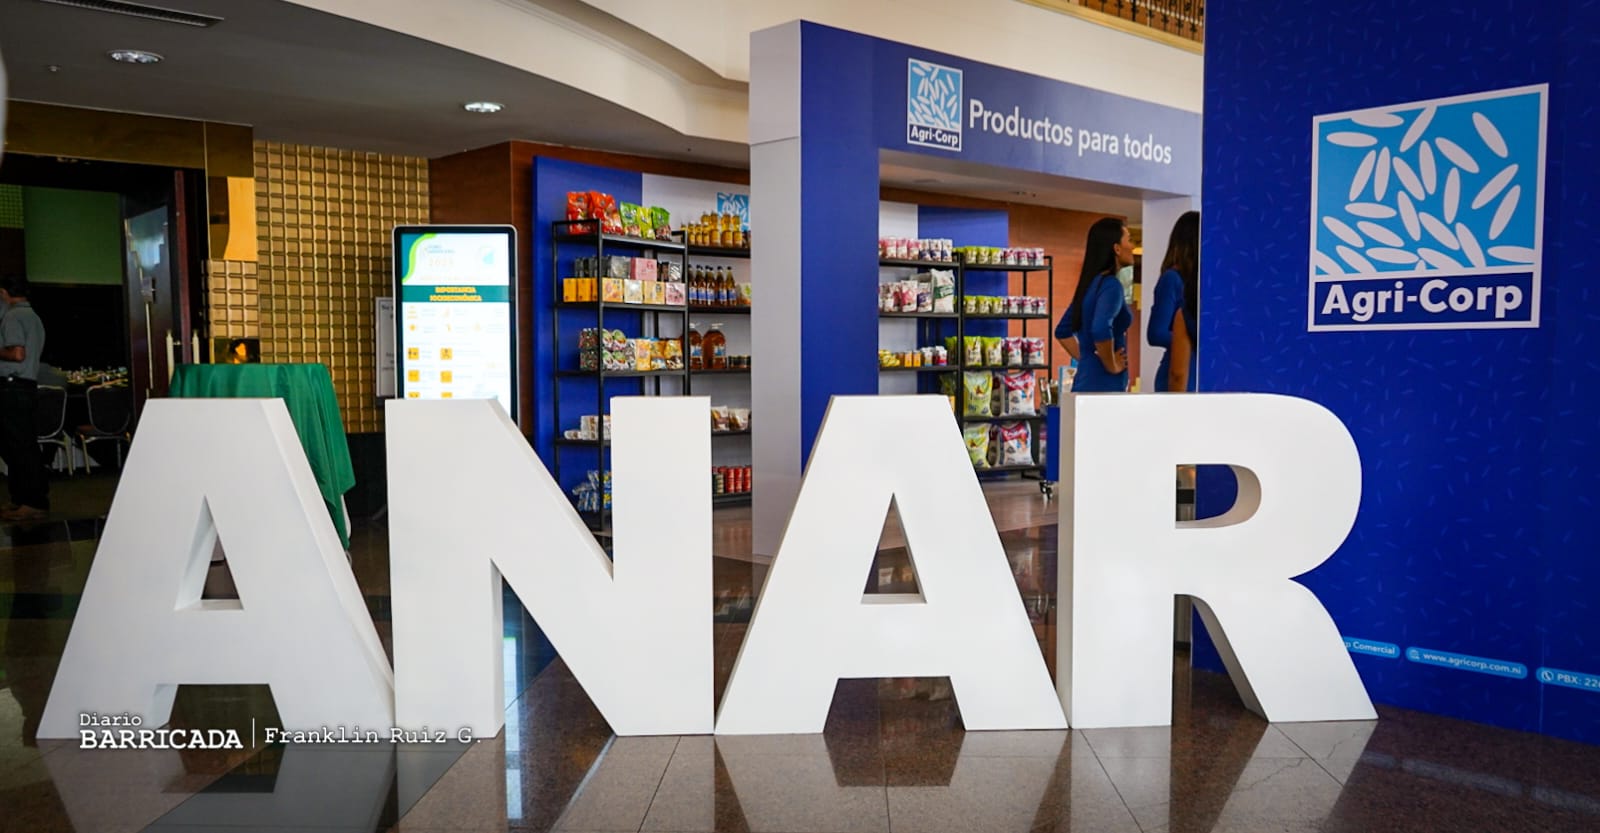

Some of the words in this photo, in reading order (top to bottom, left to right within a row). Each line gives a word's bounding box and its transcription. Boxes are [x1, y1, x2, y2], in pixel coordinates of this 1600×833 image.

[910, 126, 959, 146] Agri-Corp
[969, 99, 1073, 147] Productos
[1078, 129, 1119, 155] para
[1124, 134, 1172, 164] todos
[1321, 279, 1524, 322] Agri-Corp
[37, 394, 1378, 739] ANAR
[1353, 641, 1396, 655] Comercial
[1423, 652, 1522, 675] www.agricorp.com.ni
[1557, 672, 1582, 685] PBX:
[1584, 677, 1600, 689] 22
